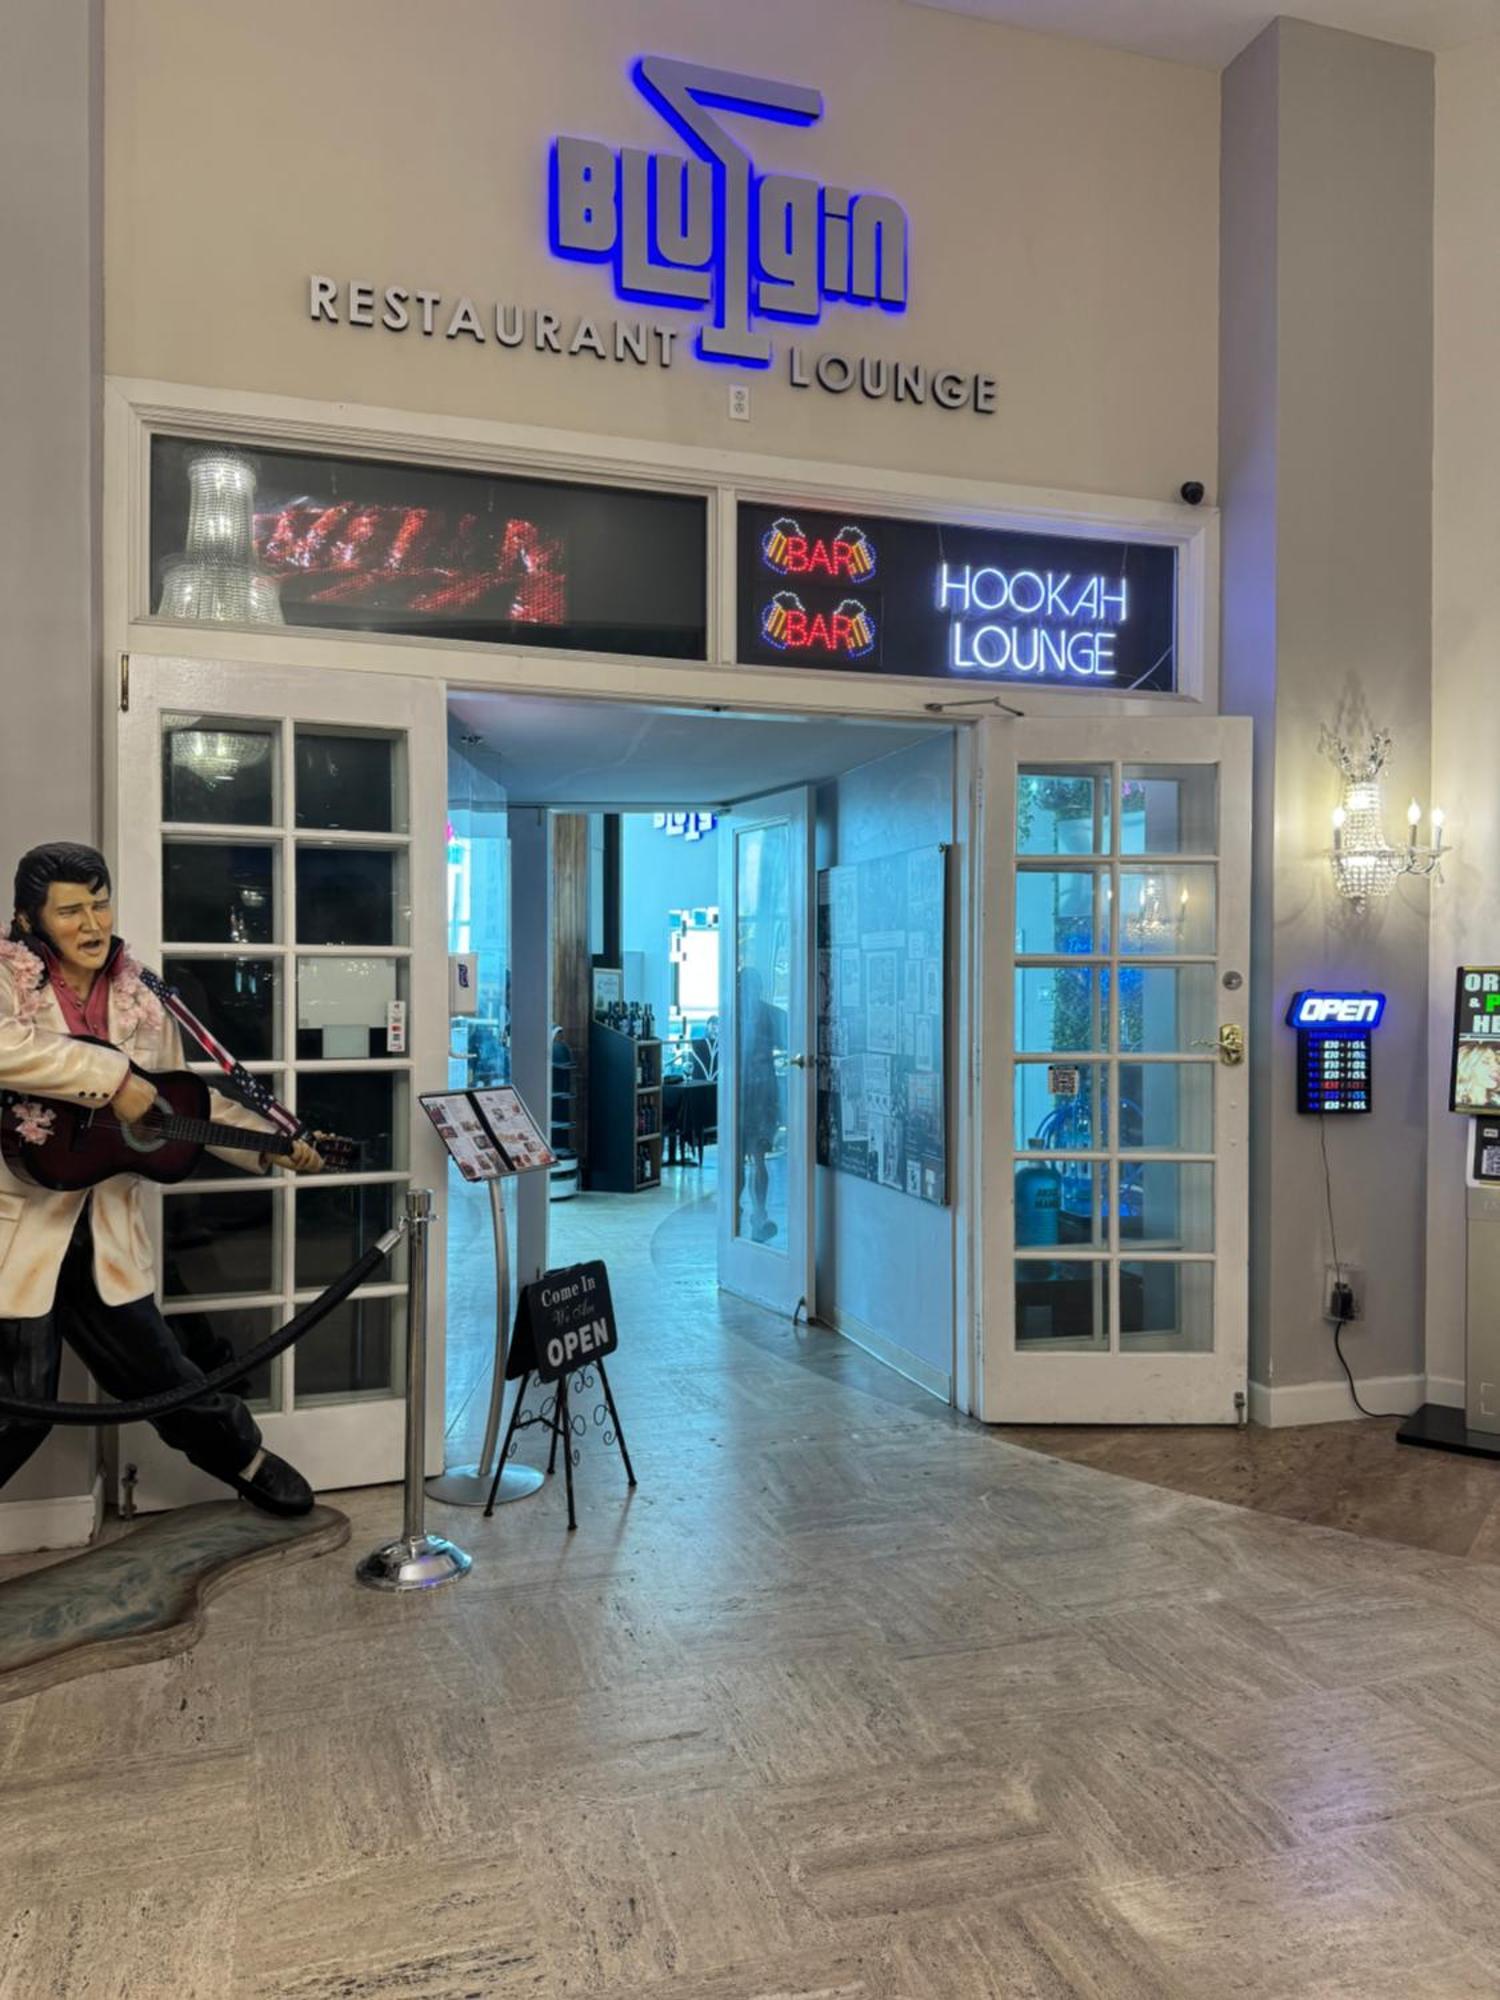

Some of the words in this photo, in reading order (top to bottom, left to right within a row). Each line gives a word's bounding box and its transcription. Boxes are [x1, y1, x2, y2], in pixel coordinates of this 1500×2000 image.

[309, 275, 680, 368] RESTAURANT
[788, 347, 998, 413] LOUNGE
[785, 536, 856, 577] BAR
[939, 562, 1127, 622] HOOKAH
[785, 610, 855, 652] BAR
[953, 621, 1118, 675] LOUNGE
[1299, 998, 1379, 1022] OPEN
[541, 1284, 579, 1307] Come
[580, 1275, 596, 1293] In
[547, 1317, 609, 1367] OPEN
